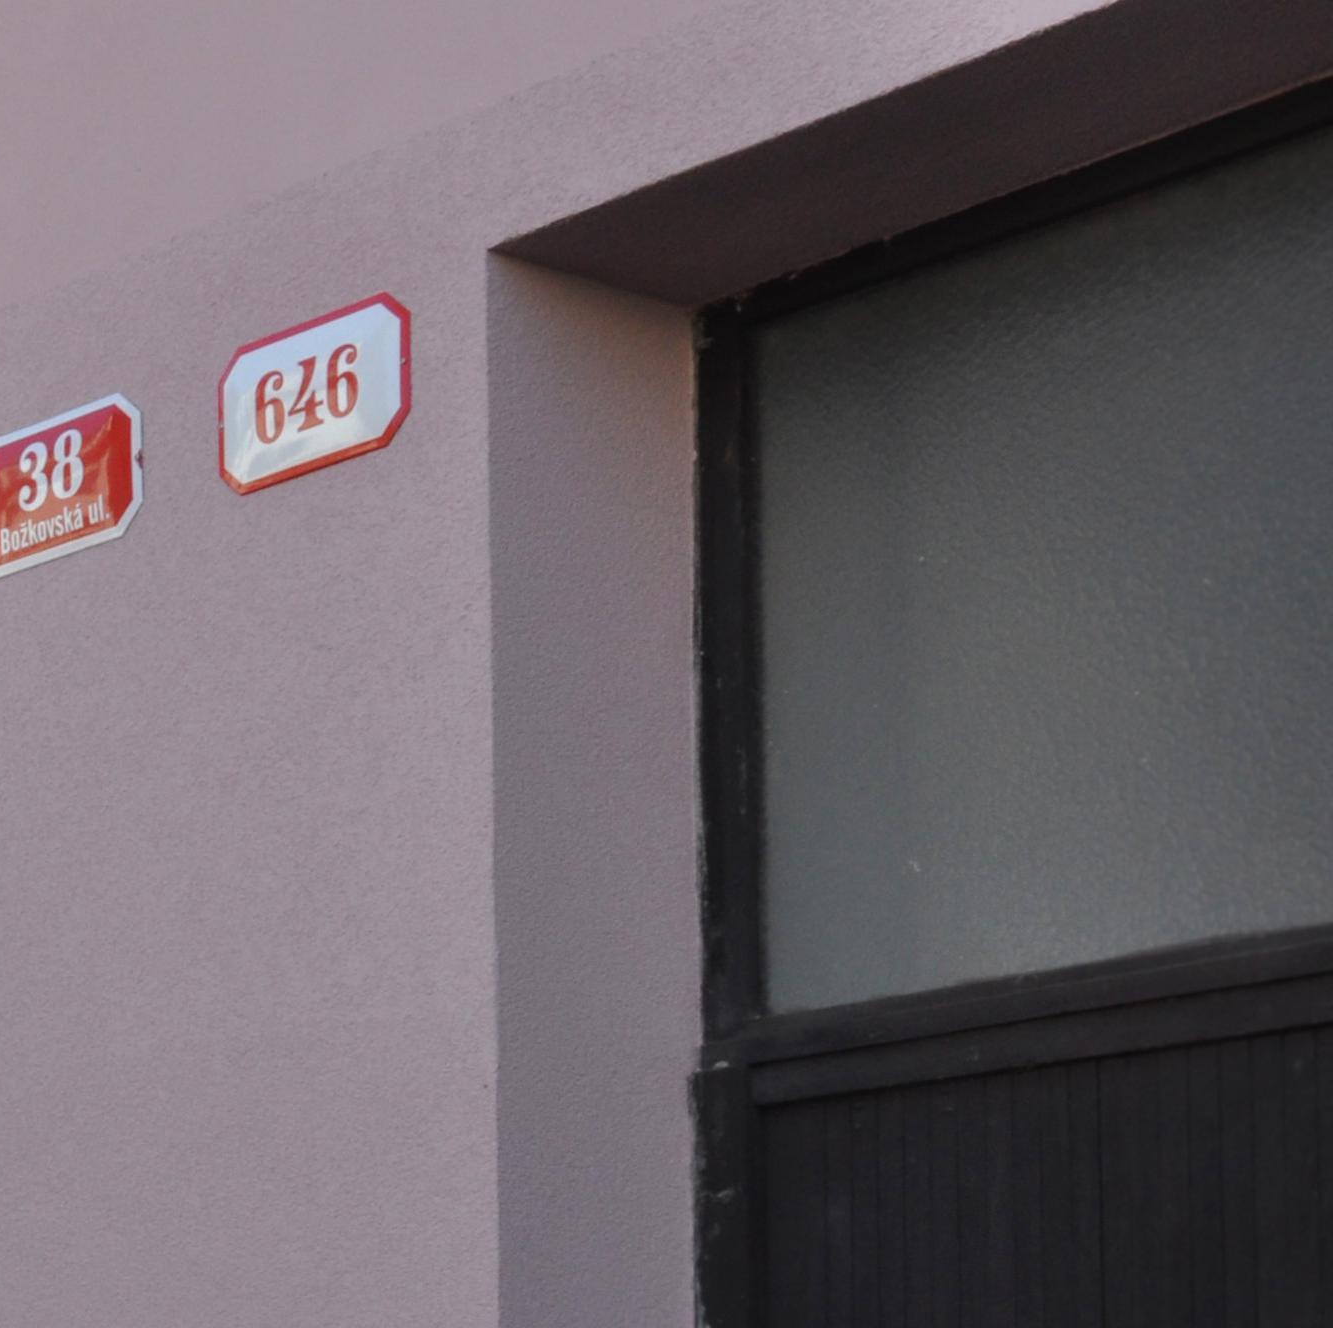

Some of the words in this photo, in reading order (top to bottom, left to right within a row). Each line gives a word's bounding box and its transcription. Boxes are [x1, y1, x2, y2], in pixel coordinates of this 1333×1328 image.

[254, 343, 359, 445] 646
[17, 428, 84, 512] 38
[0, 503, 85, 556] Božkovská
[88, 494, 111, 525] ul.
